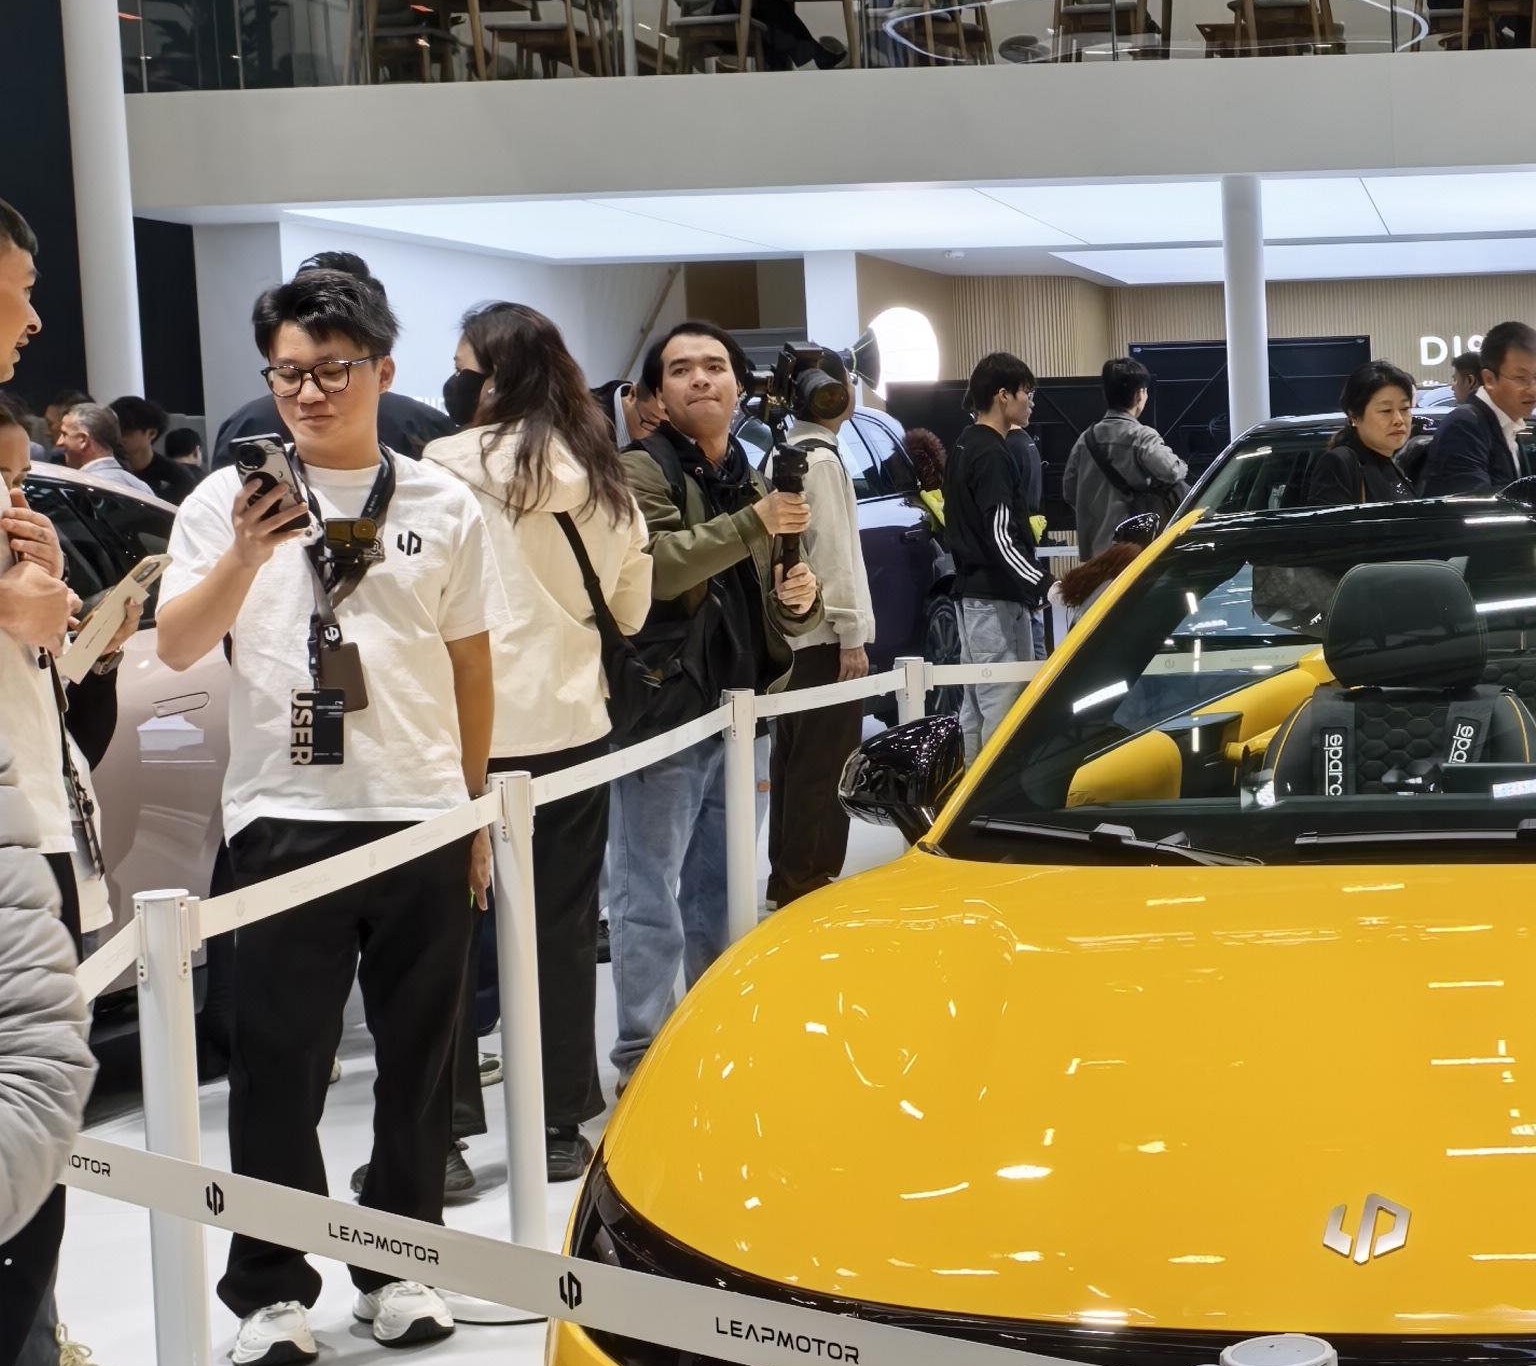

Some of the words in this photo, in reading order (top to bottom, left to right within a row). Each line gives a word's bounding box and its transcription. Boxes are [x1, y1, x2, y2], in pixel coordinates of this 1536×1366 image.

[291, 689, 314, 765] USER
[67, 1153, 111, 1177] OTOR
[328, 1222, 440, 1266] LEAPMOTOR
[714, 1316, 860, 1365] LEAPMOTOR
